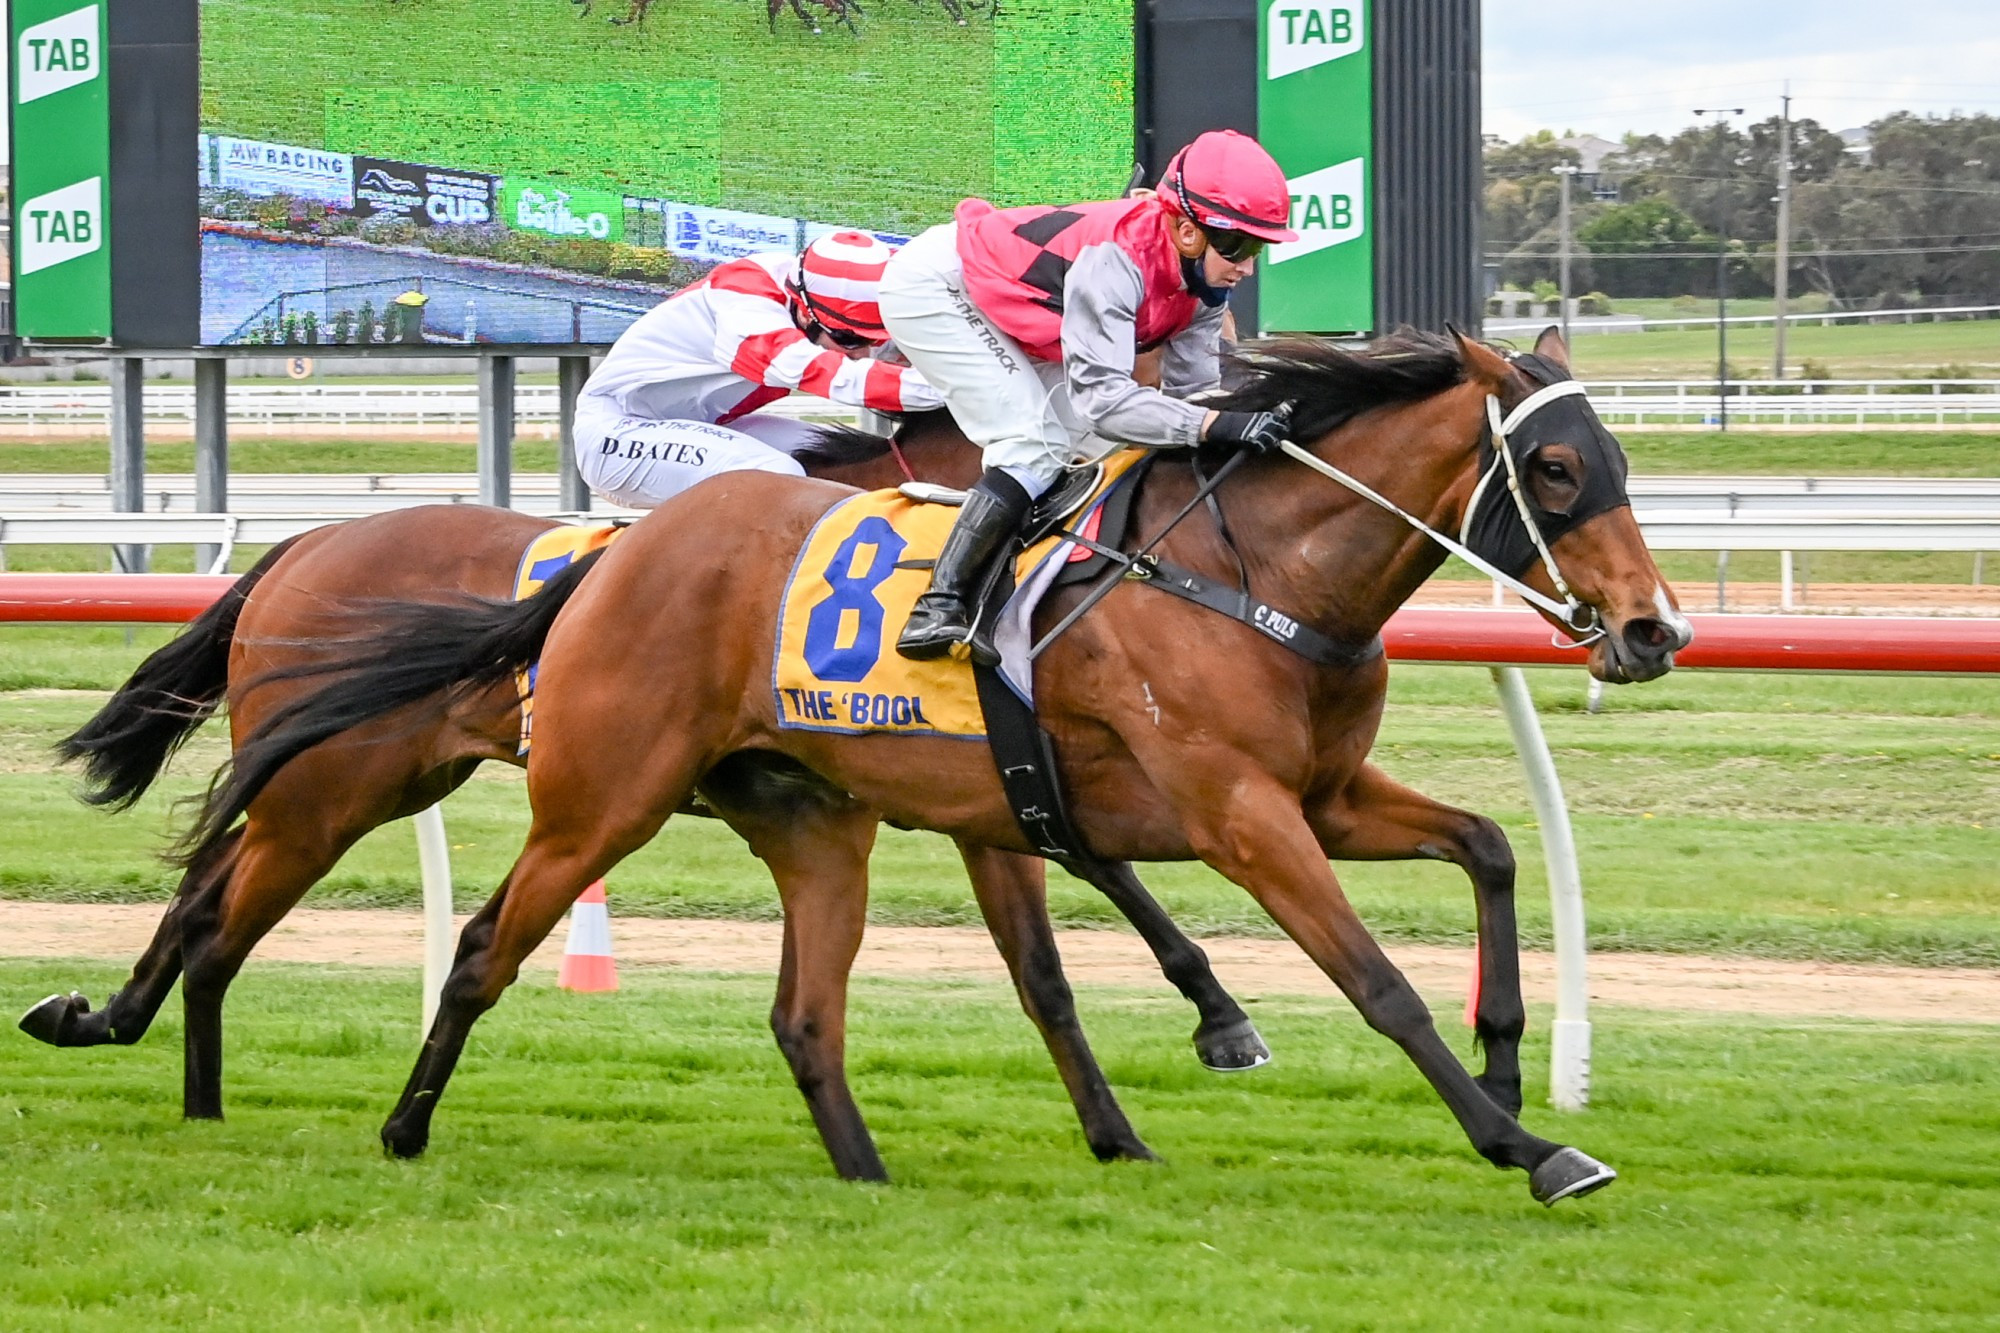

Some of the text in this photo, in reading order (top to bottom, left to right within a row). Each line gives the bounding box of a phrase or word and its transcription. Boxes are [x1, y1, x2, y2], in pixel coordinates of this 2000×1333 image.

[1279, 8, 1352, 45] TAB
[27, 38, 90, 72] TAB
[266, 148, 343, 173] RACING
[30, 210, 92, 243] TAB
[1288, 194, 1352, 230] TAB
[978, 327, 1021, 375] TRACK
[600, 436, 708, 467] D.BATES
[803, 516, 908, 682] 8
[1254, 604, 1268, 621] C
[1265, 609, 1299, 639] PULS
[784, 688, 837, 721] THE
